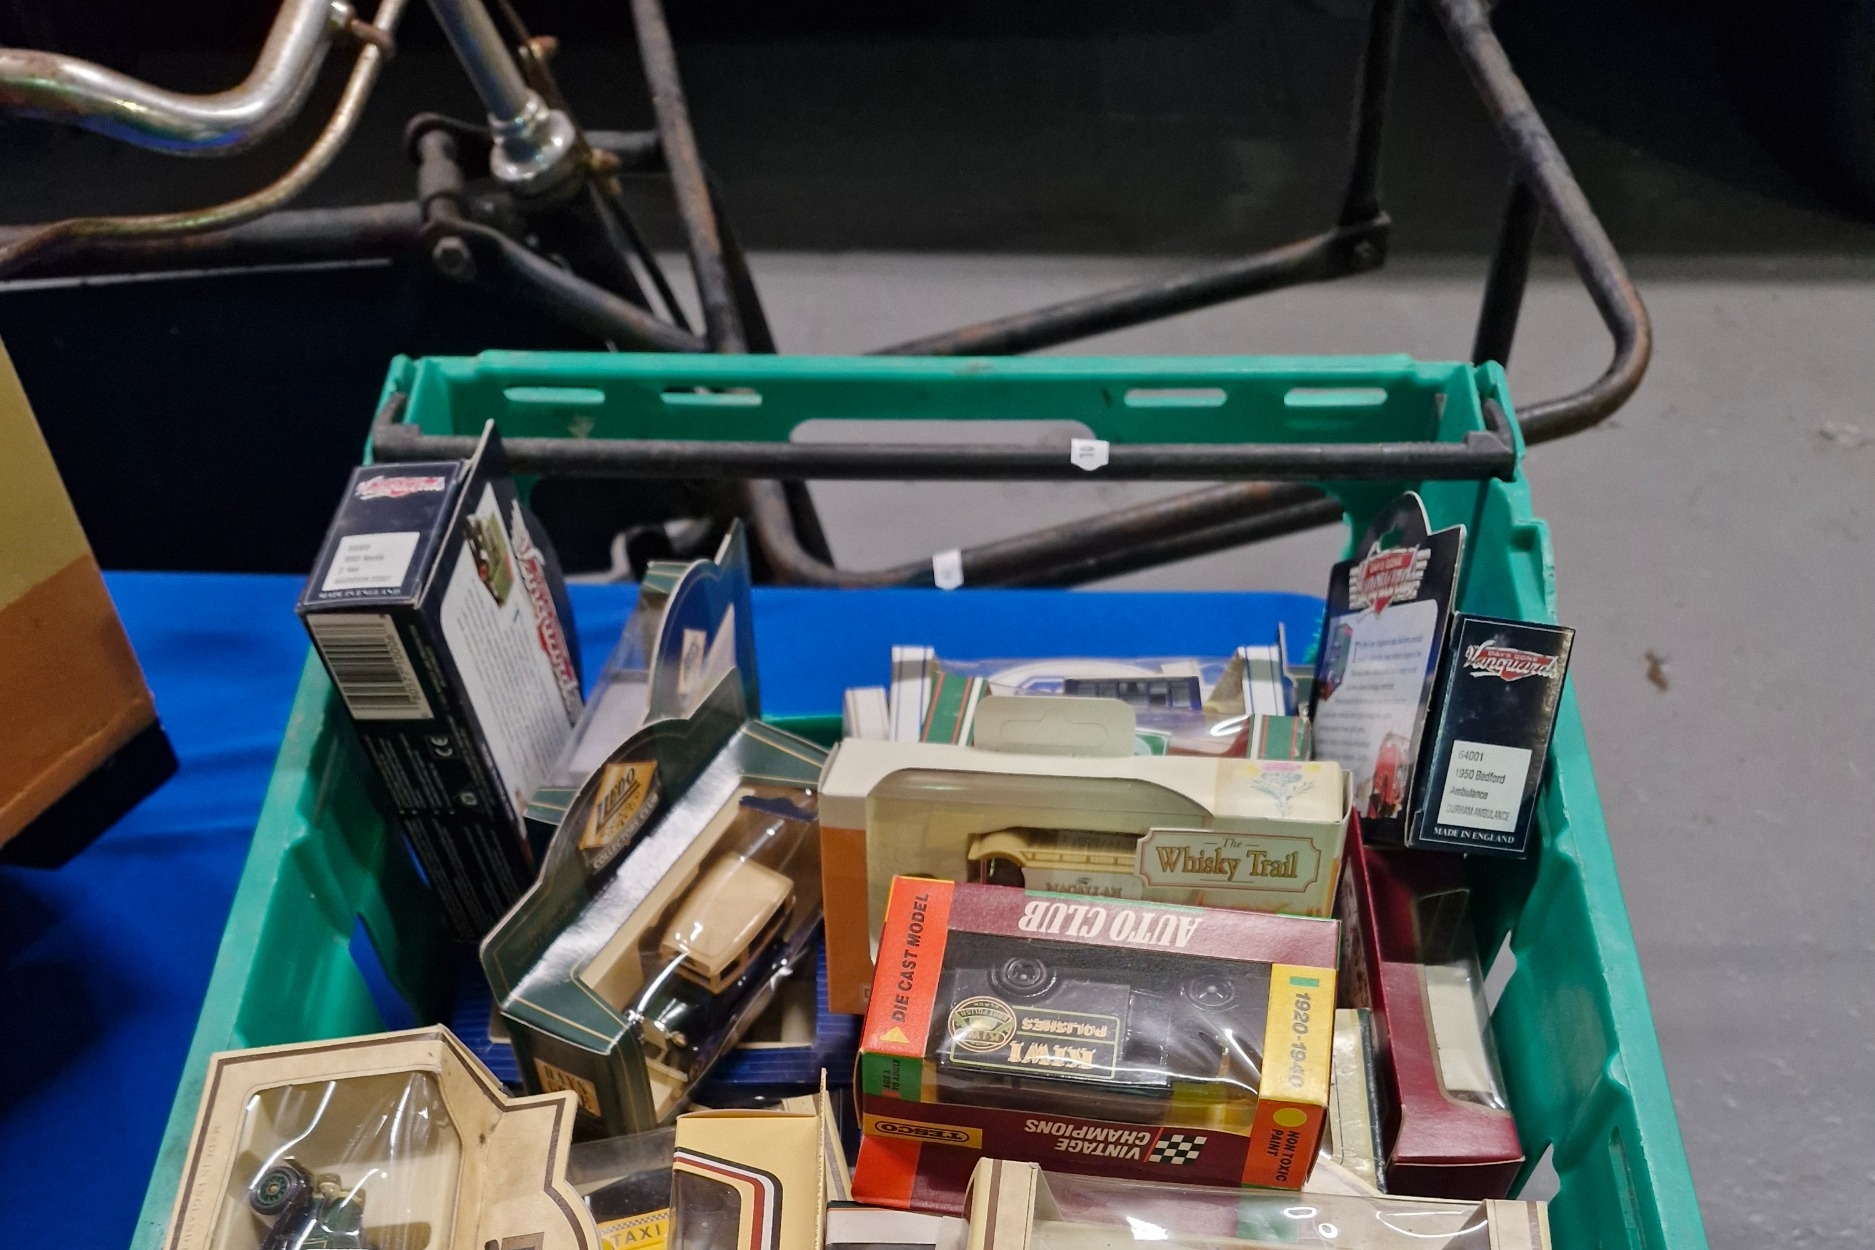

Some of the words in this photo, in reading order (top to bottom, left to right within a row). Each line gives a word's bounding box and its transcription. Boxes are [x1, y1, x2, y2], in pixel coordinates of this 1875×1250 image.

[1456, 768, 1475, 780] 1950
[1476, 770, 1506, 784] Bedford
[1450, 786, 1488, 800] Ambulance
[1222, 837, 1243, 849] The
[1434, 827, 1459, 838] MADE
[1461, 830, 1471, 838] IN
[1472, 831, 1515, 843] ENGLAND
[1156, 846, 1241, 881] Whisky
[1246, 850, 1299, 879] Trail
[909, 893, 930, 949] MODEL
[1018, 901, 1107, 939] CLUB
[1109, 909, 1204, 948] AUTO
[898, 949, 918, 992] CAST
[892, 994, 910, 1023] DIE
[1021, 1016, 1108, 1038] POLISHES
[1288, 993, 1311, 1089] 1920-1940
[1007, 1040, 1097, 1070] KIWI
[880, 1121, 964, 1142] TESCO
[1024, 1119, 1151, 1145] CHAMPIONS
[1267, 1128, 1284, 1157] PAINT
[1284, 1131, 1300, 1152] NON
[1055, 1138, 1140, 1160] VINTAGE
[1275, 1153, 1295, 1182] TOXIC
[610, 1224, 661, 1247] TAXI
